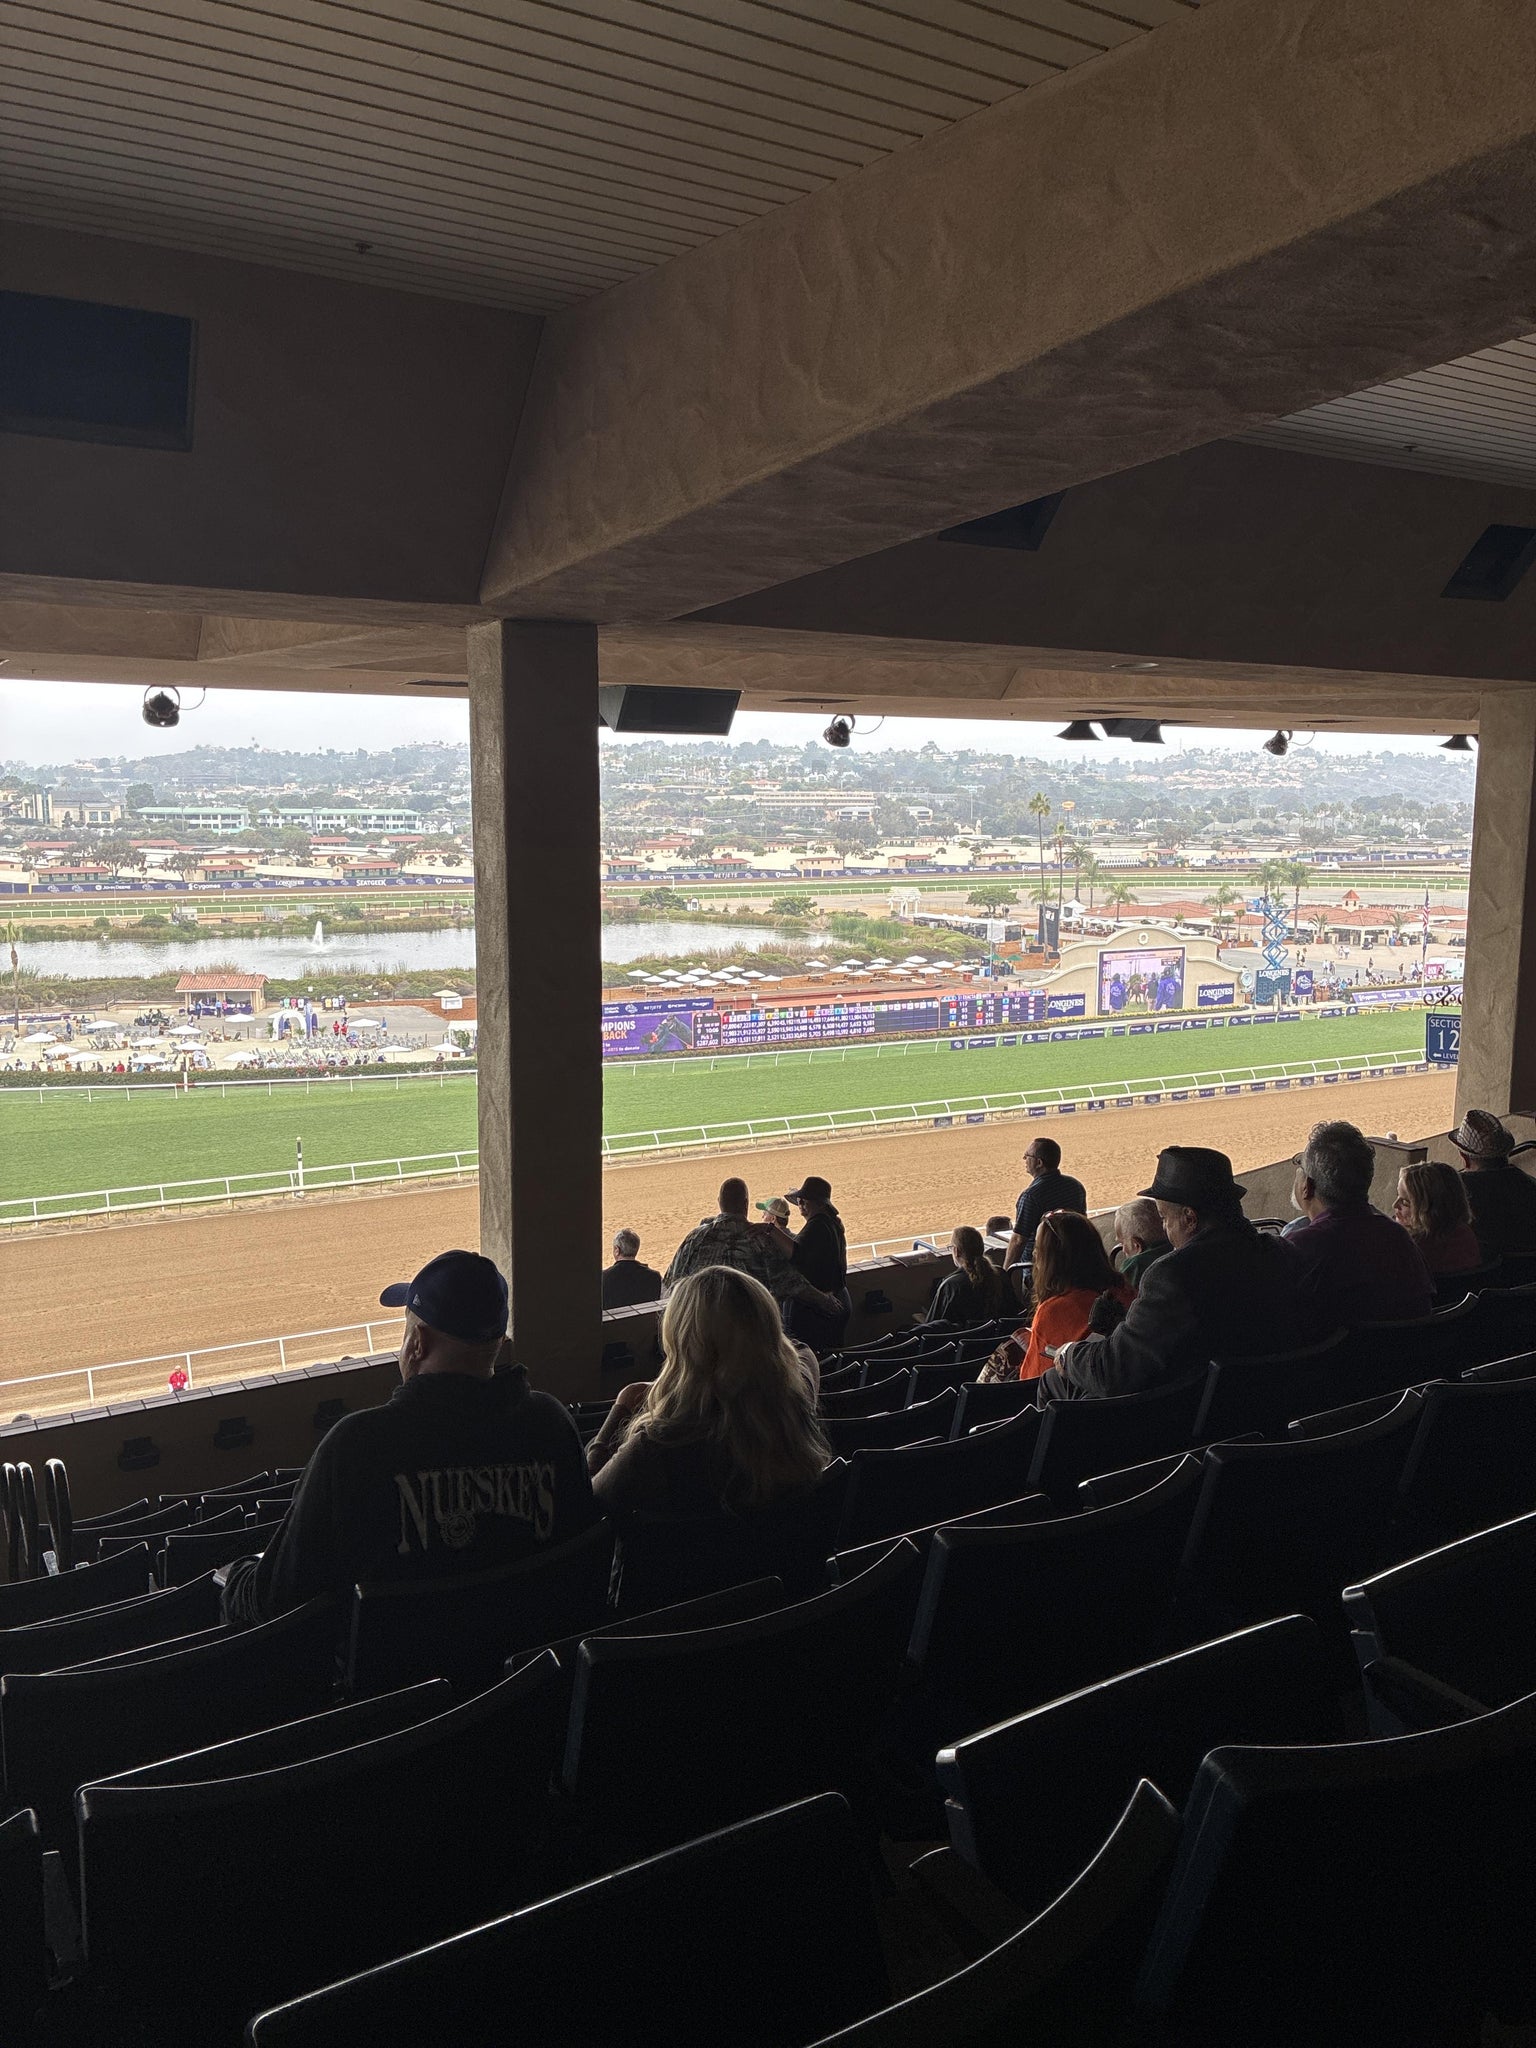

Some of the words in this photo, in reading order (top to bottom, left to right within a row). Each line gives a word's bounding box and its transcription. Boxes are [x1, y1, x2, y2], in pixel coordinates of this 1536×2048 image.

[1258, 969, 1290, 978] LONGINES
[1199, 988, 1233, 998] LONGINES
[603, 1031, 627, 1041] BACK
[1438, 1029, 1460, 1050] 12
[393, 1461, 556, 1554] NUESKE'S
